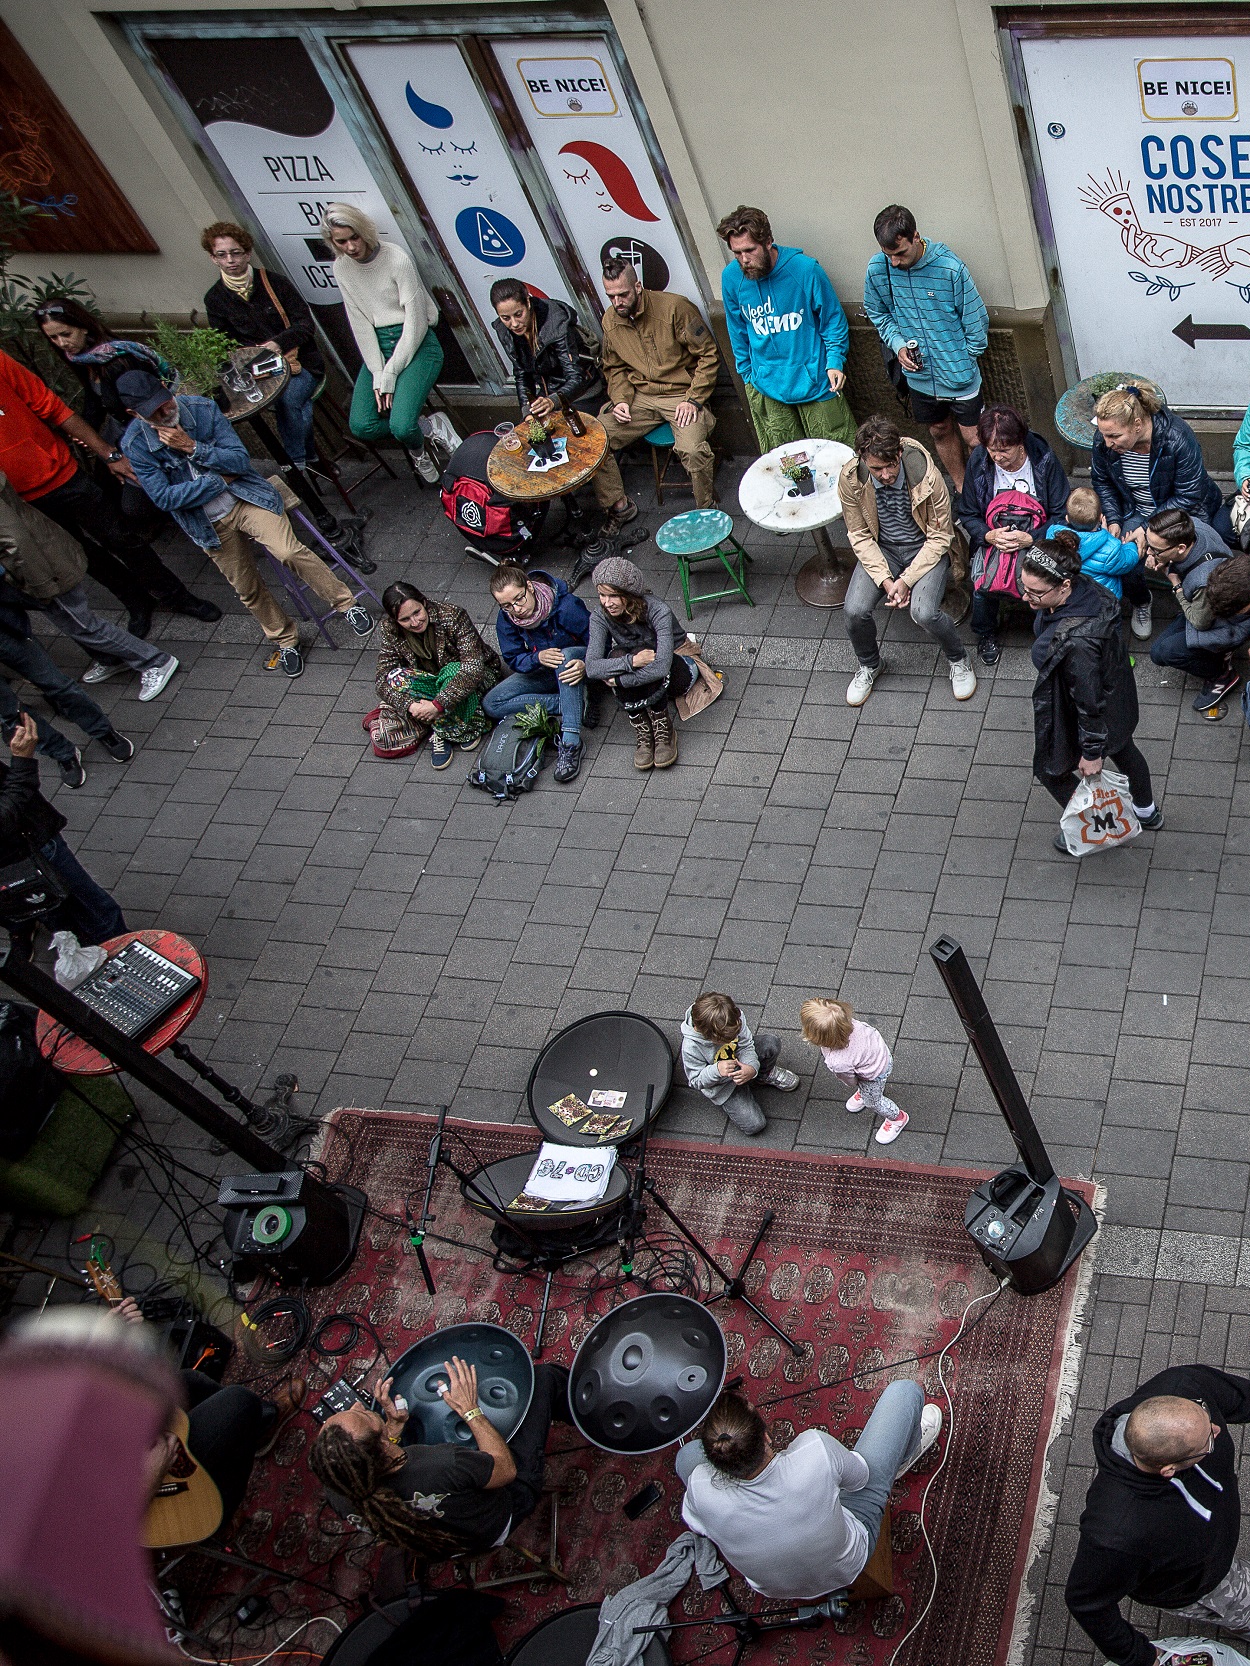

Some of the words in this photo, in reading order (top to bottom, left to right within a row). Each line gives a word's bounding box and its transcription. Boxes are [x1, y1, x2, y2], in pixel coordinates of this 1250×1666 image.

[526, 79, 552, 93] BE
[554, 78, 607, 92] NICE!
[1143, 81, 1169, 95] BE
[1175, 81, 1232, 95] NICE!
[263, 155, 335, 182] PIZZA
[298, 201, 335, 227] BA
[1180, 218, 1197, 227] EST
[1199, 218, 1222, 227] 2017
[302, 265, 340, 289] ICE
[1091, 811, 1118, 833] M
